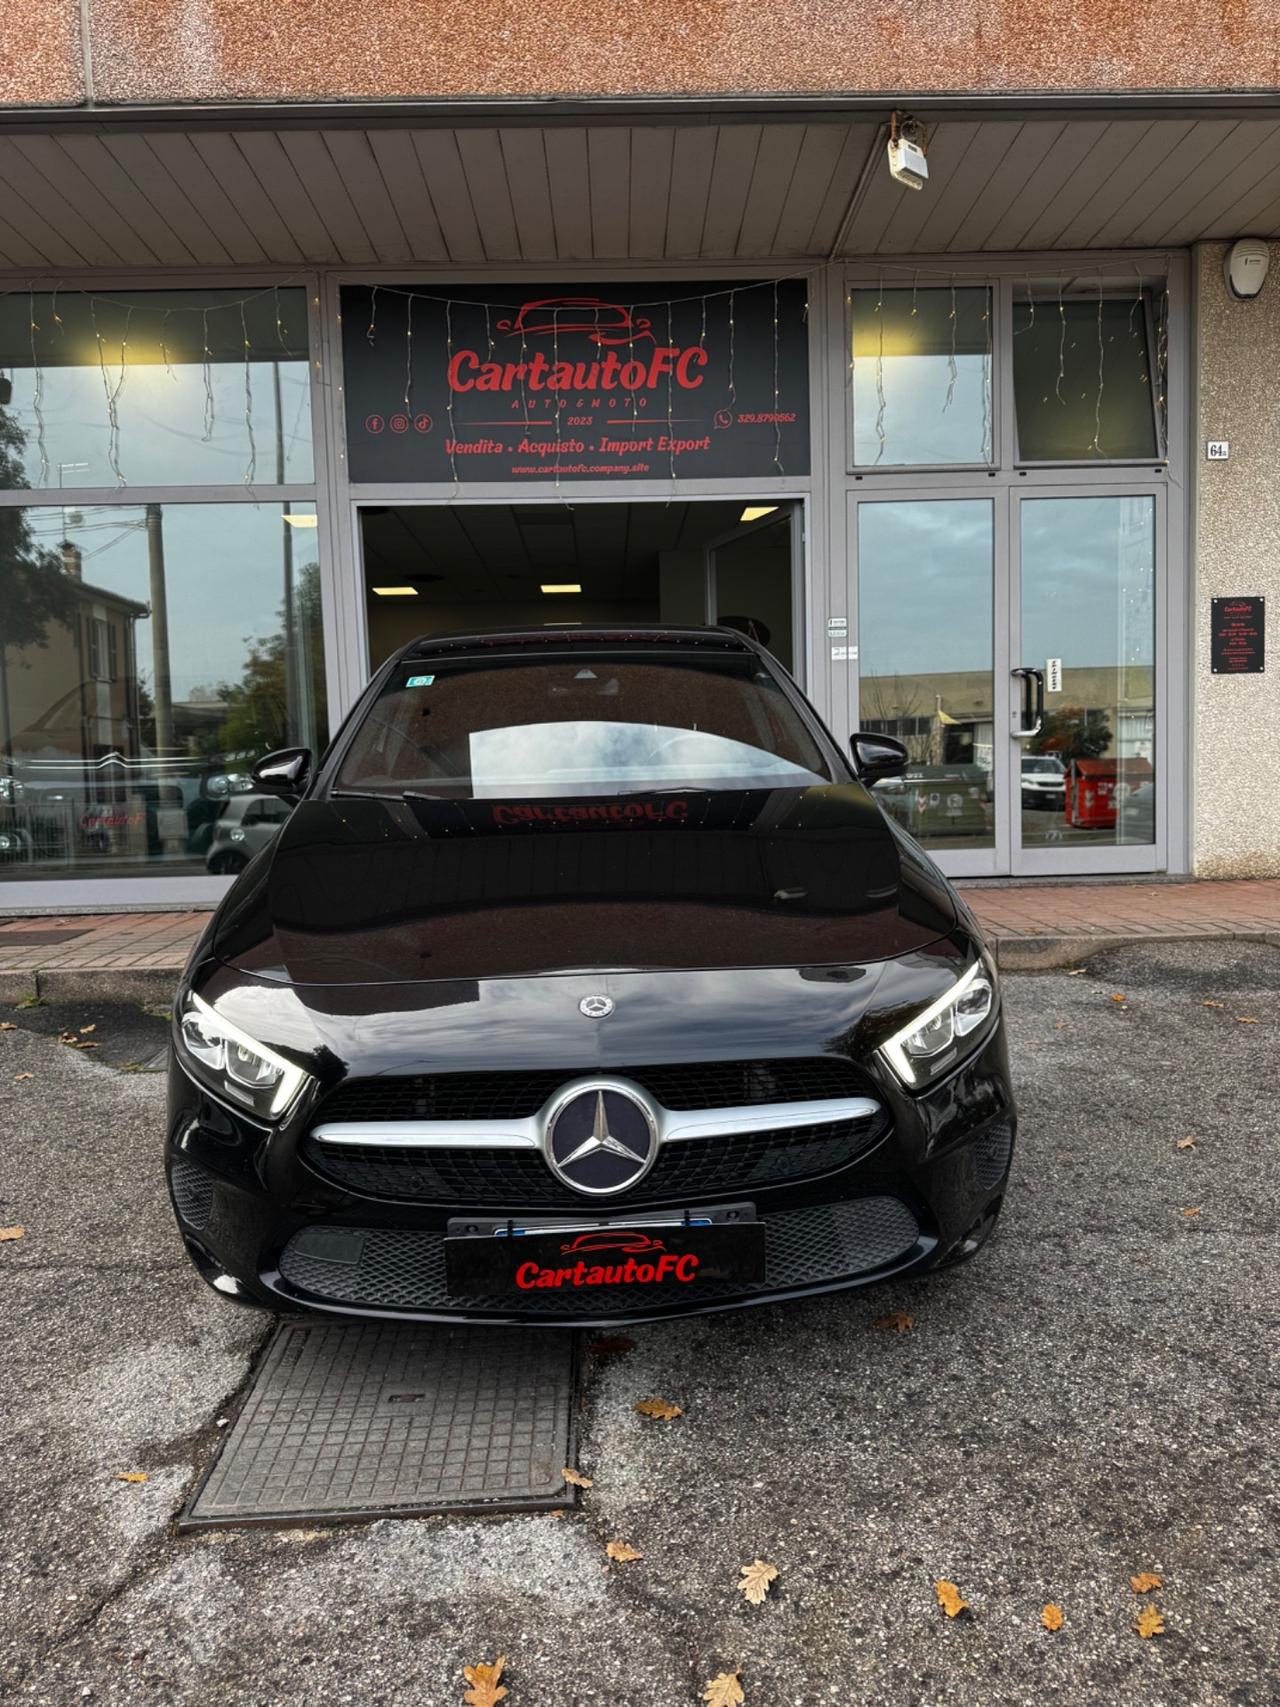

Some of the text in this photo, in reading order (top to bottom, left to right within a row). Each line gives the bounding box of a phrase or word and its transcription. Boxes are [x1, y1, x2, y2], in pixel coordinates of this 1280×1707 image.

[447, 346, 708, 392] CartautoFC
[567, 416, 593, 426] 2023
[445, 436, 711, 458] Vendita Acquisto Import Export
[515, 1254, 699, 1289] CartautoFC
